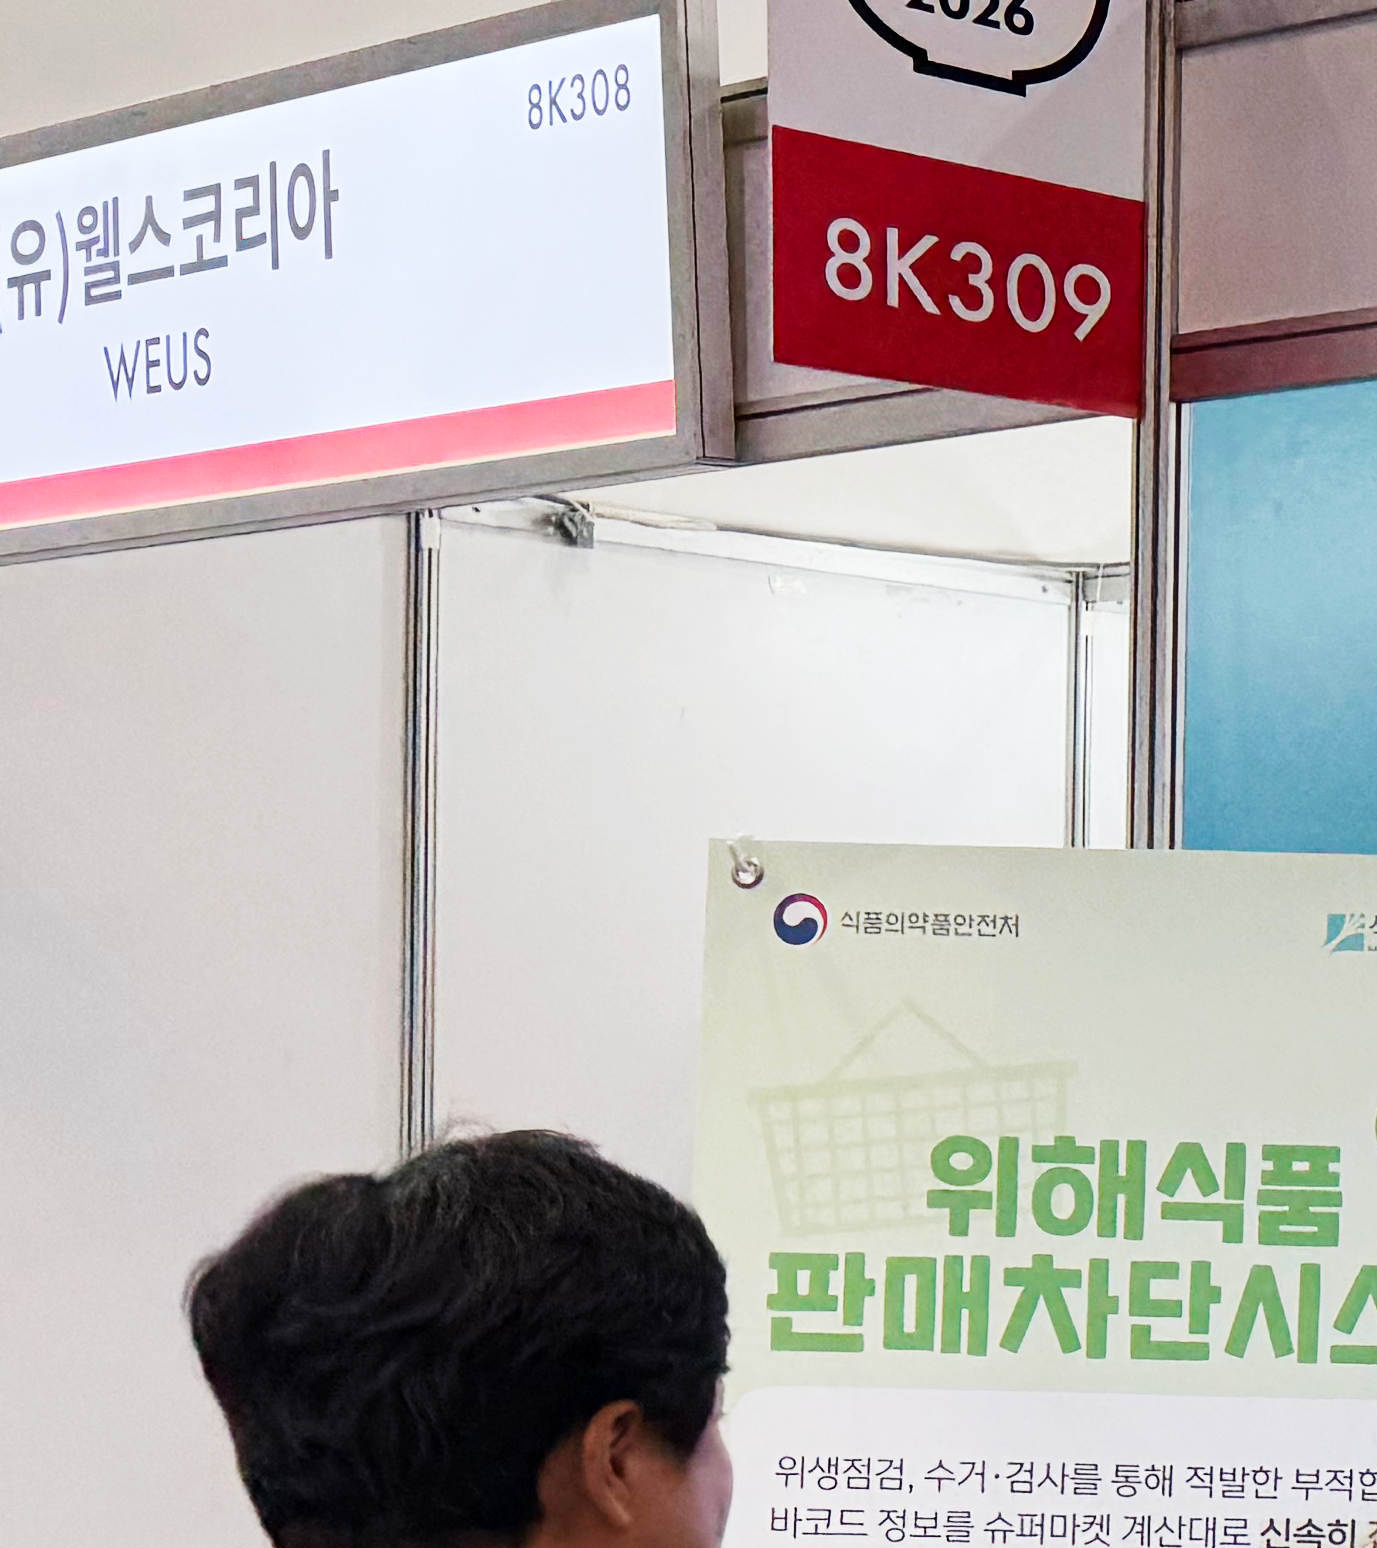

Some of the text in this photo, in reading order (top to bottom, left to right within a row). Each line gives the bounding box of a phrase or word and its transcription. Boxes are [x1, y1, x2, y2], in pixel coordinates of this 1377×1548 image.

[527, 64, 631, 130] 8K308
[0, 149, 340, 333] 유)웰스코리아
[825, 217, 1111, 341] 8K309
[103, 327, 212, 402] WEUS
[840, 911, 1020, 938] 식품의약품안전처
[926, 1135, 1344, 1247] 위해식품
[775, 1456, 914, 1494] 위생점검,
[1111, 1464, 1174, 1498] 통해
[1185, 1465, 1283, 1500] 적발한
[770, 1506, 868, 1538] 바코드
[878, 1508, 974, 1543] 정보를
[983, 1511, 1111, 1547] 슈퍼마켓
[1121, 1514, 1251, 1548] 계산대로
